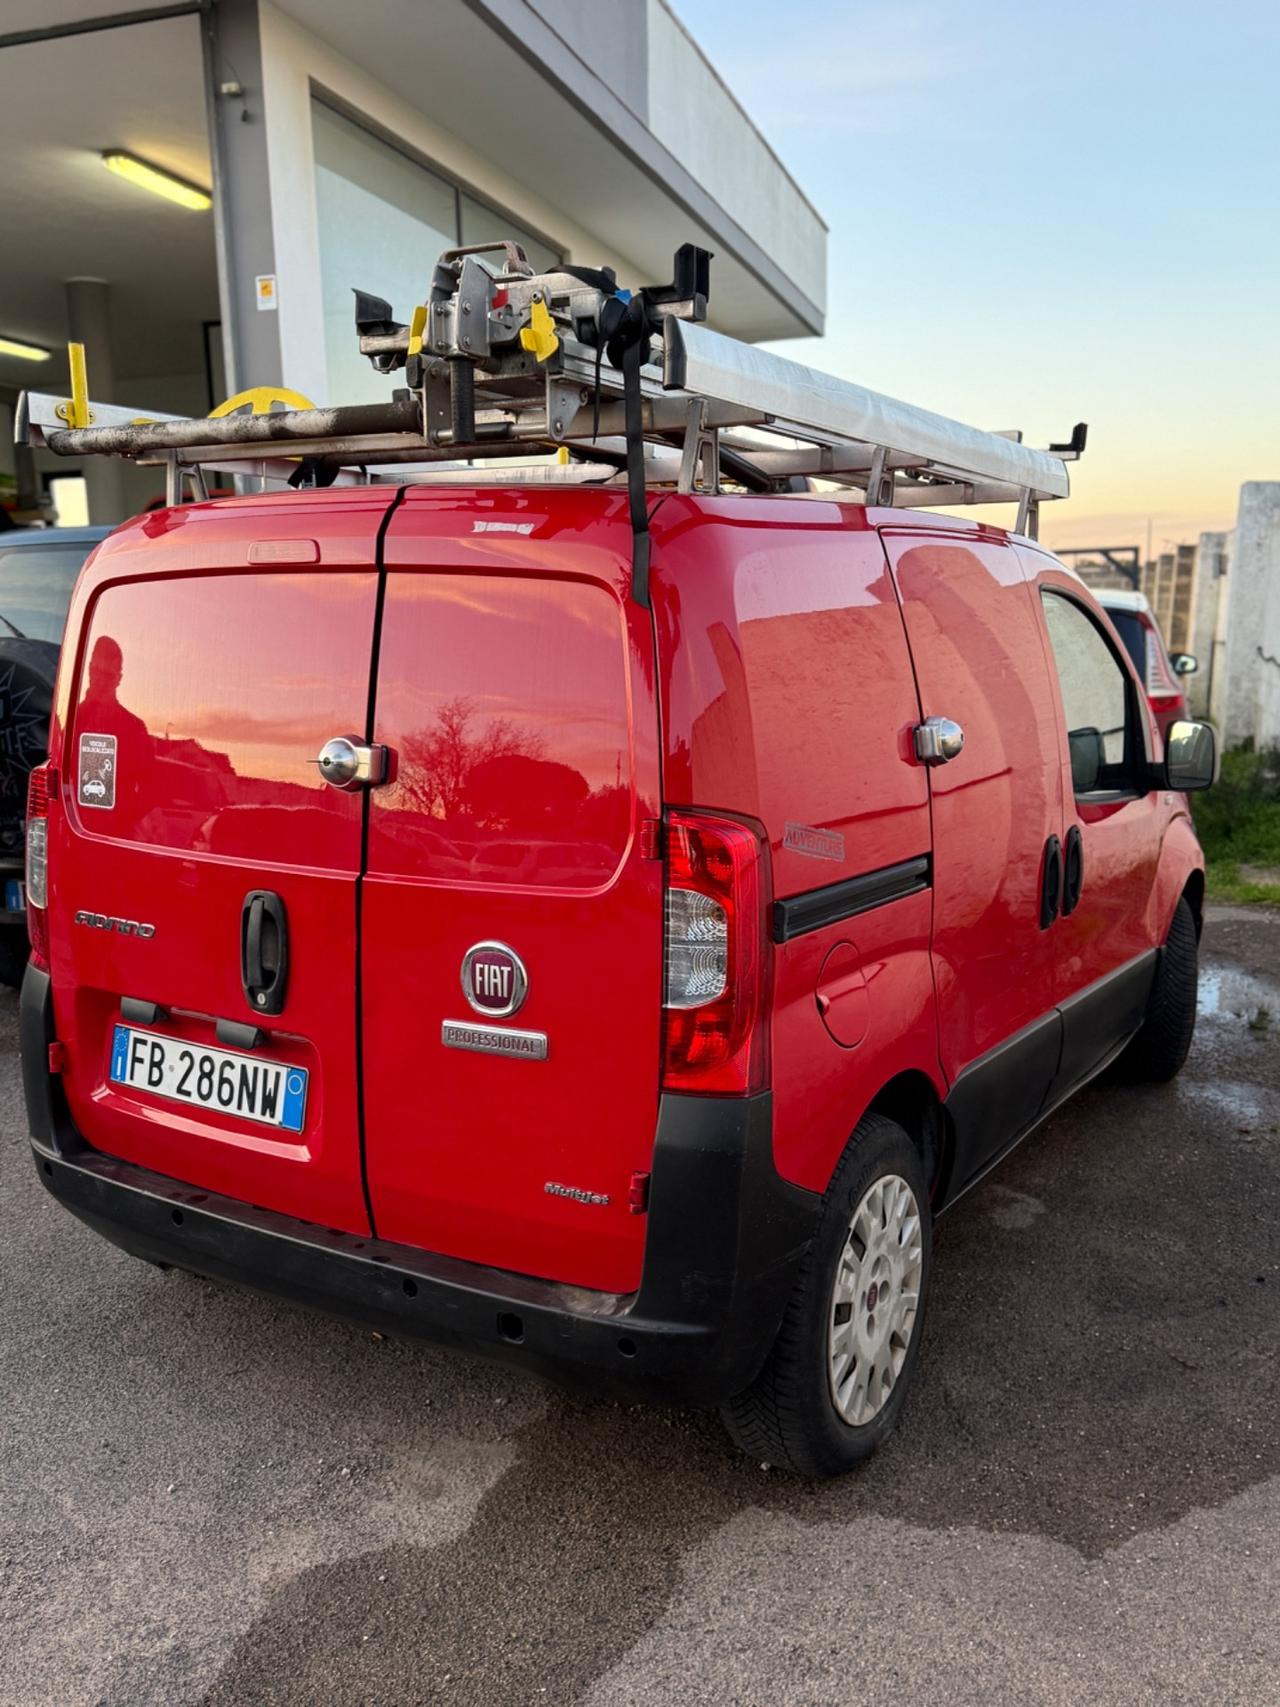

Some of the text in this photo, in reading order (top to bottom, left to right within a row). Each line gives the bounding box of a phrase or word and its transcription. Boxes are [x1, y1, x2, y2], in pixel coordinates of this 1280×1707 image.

[475, 963, 511, 998] FIAT
[447, 1028, 537, 1053] PROFESSIONAL
[130, 1037, 281, 1119] FB 286NW
